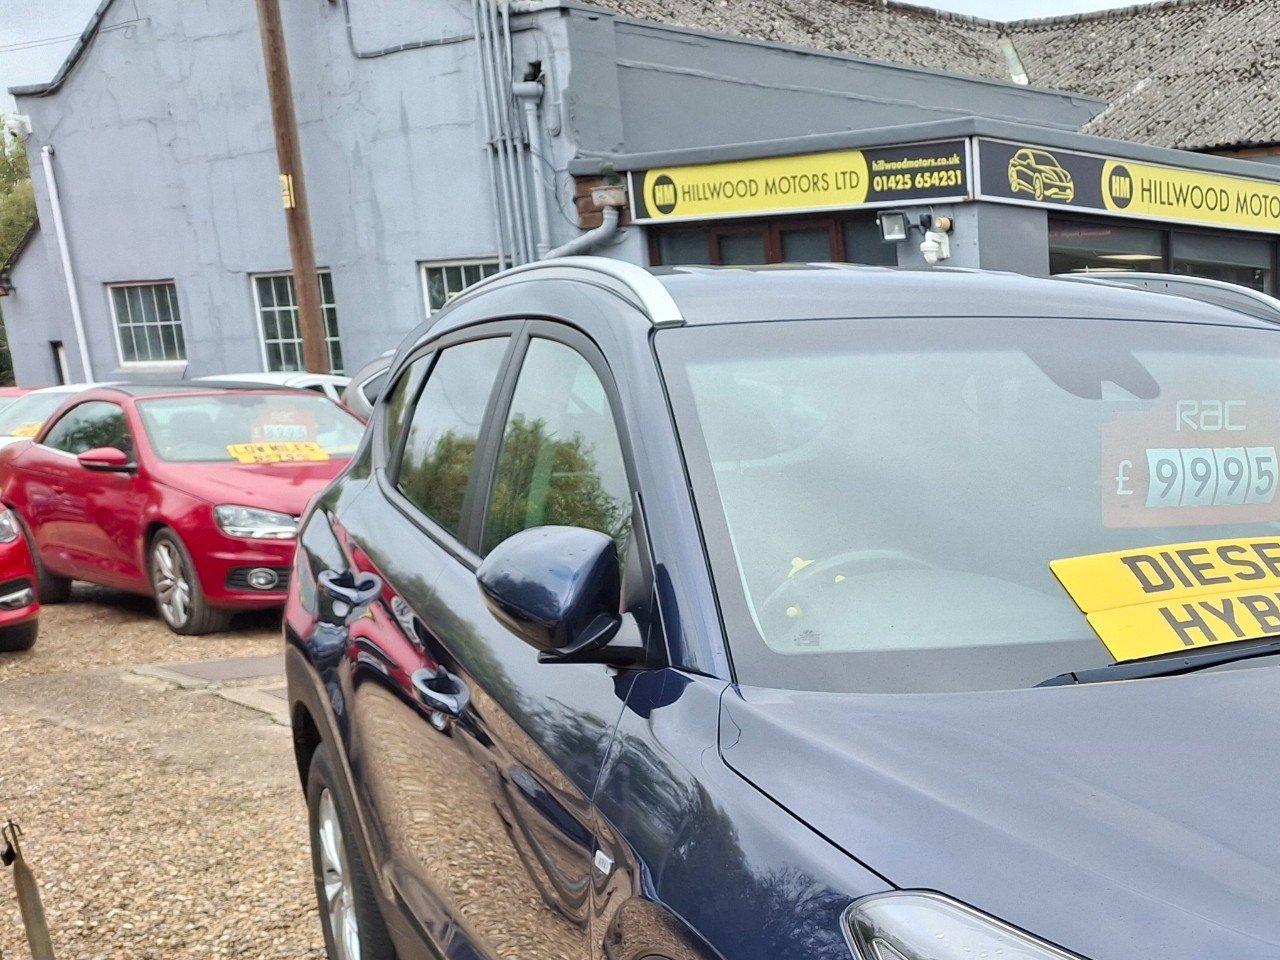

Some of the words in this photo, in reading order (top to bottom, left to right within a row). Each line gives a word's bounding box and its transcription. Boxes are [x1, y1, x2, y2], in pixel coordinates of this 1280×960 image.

[872, 153, 961, 171] hillwoodmotors.co.uk
[681, 180, 759, 202] HILLWOOD
[764, 172, 830, 196] MOTORS
[834, 170, 860, 191] LTD
[873, 174, 912, 192] 01425
[914, 169, 962, 188] 654231
[1141, 178, 1230, 213] HILLWOOD
[1116, 460, 1133, 495] £
[1155, 456, 1274, 499] 9995
